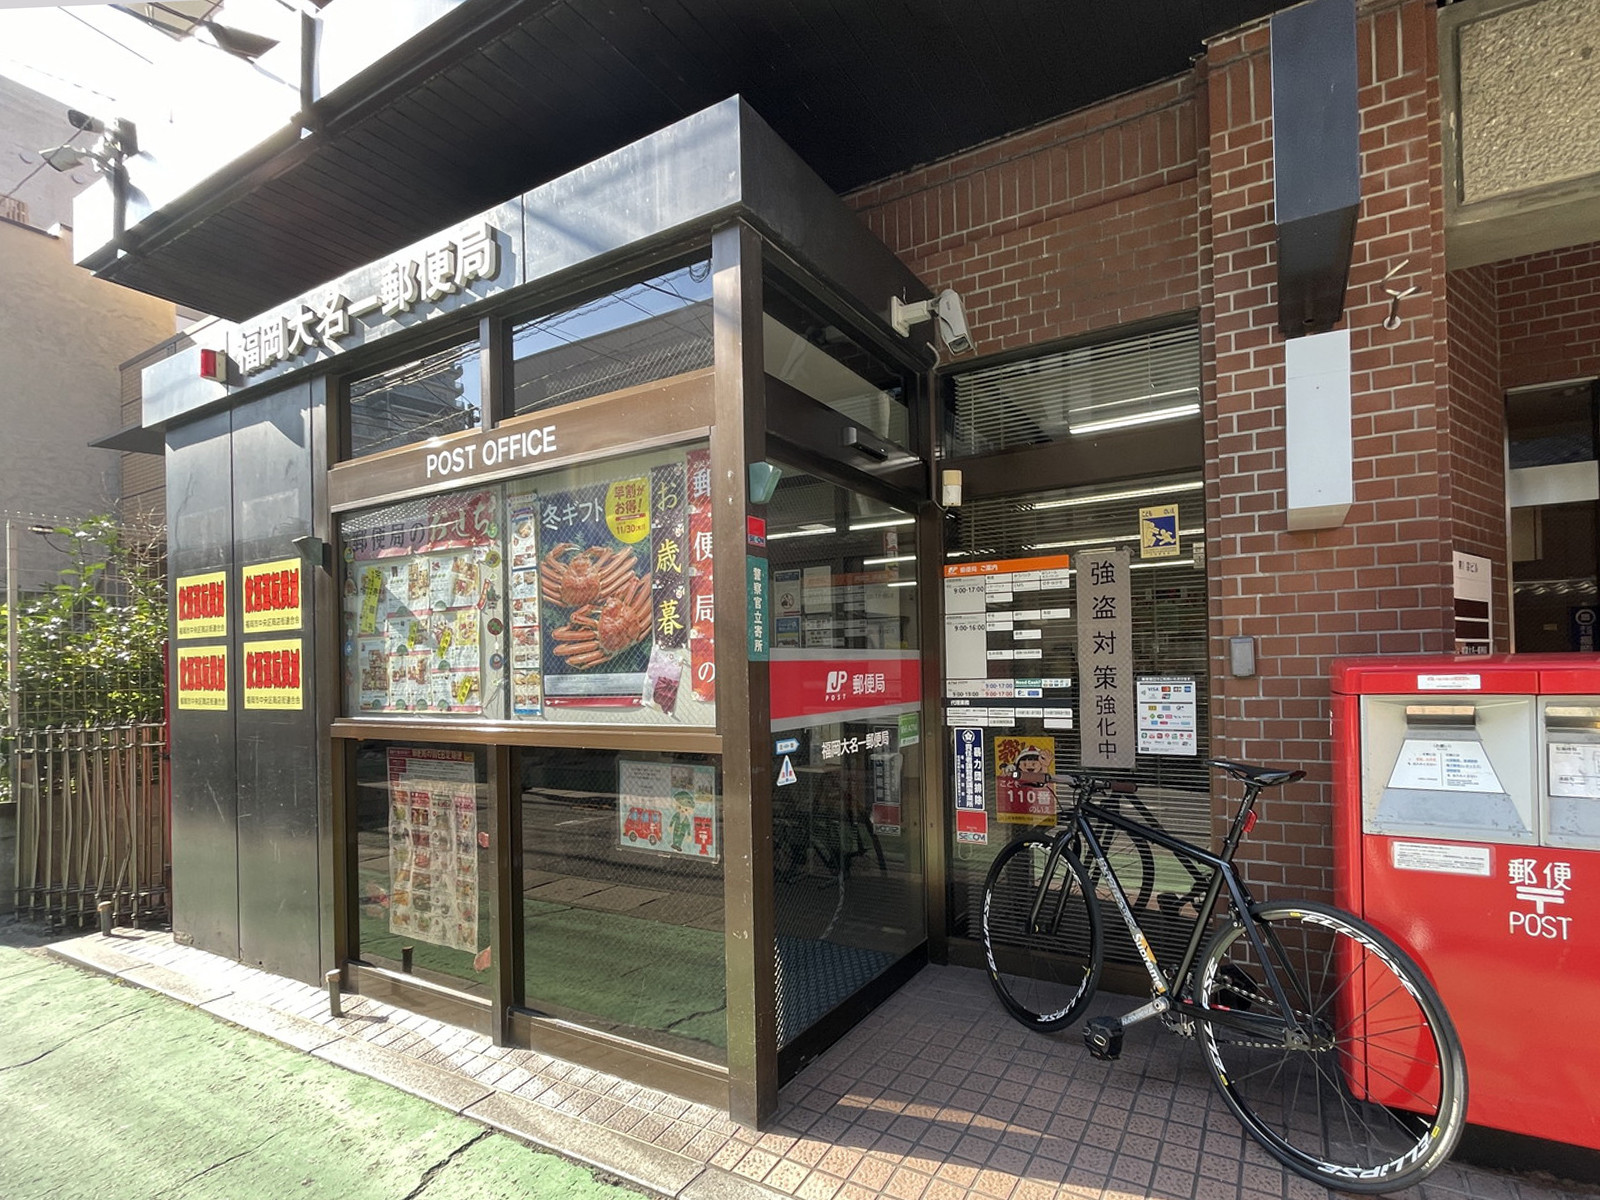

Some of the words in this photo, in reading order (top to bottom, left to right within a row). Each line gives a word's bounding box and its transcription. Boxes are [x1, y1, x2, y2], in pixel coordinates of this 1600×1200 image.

[238, 223, 497, 374] 福岡大名一郵便局
[426, 444, 475, 479] POST
[482, 425, 557, 467] OFFICE
[542, 497, 604, 531] 冬ギフト
[655, 481, 684, 636] お歳暮
[753, 567, 764, 653] 警察官立寄所
[1090, 560, 1117, 760] 強盗対策強化中
[825, 693, 847, 702] POST
[852, 673, 886, 696] 郵便局
[821, 730, 890, 760] 福岡大名一郵便局
[1007, 790, 1052, 805] 110番
[958, 832, 986, 841] SECOM
[1508, 858, 1572, 891] 郵便
[1509, 911, 1573, 940] POST
[1317, 1130, 1430, 1179] ELLIPSE
